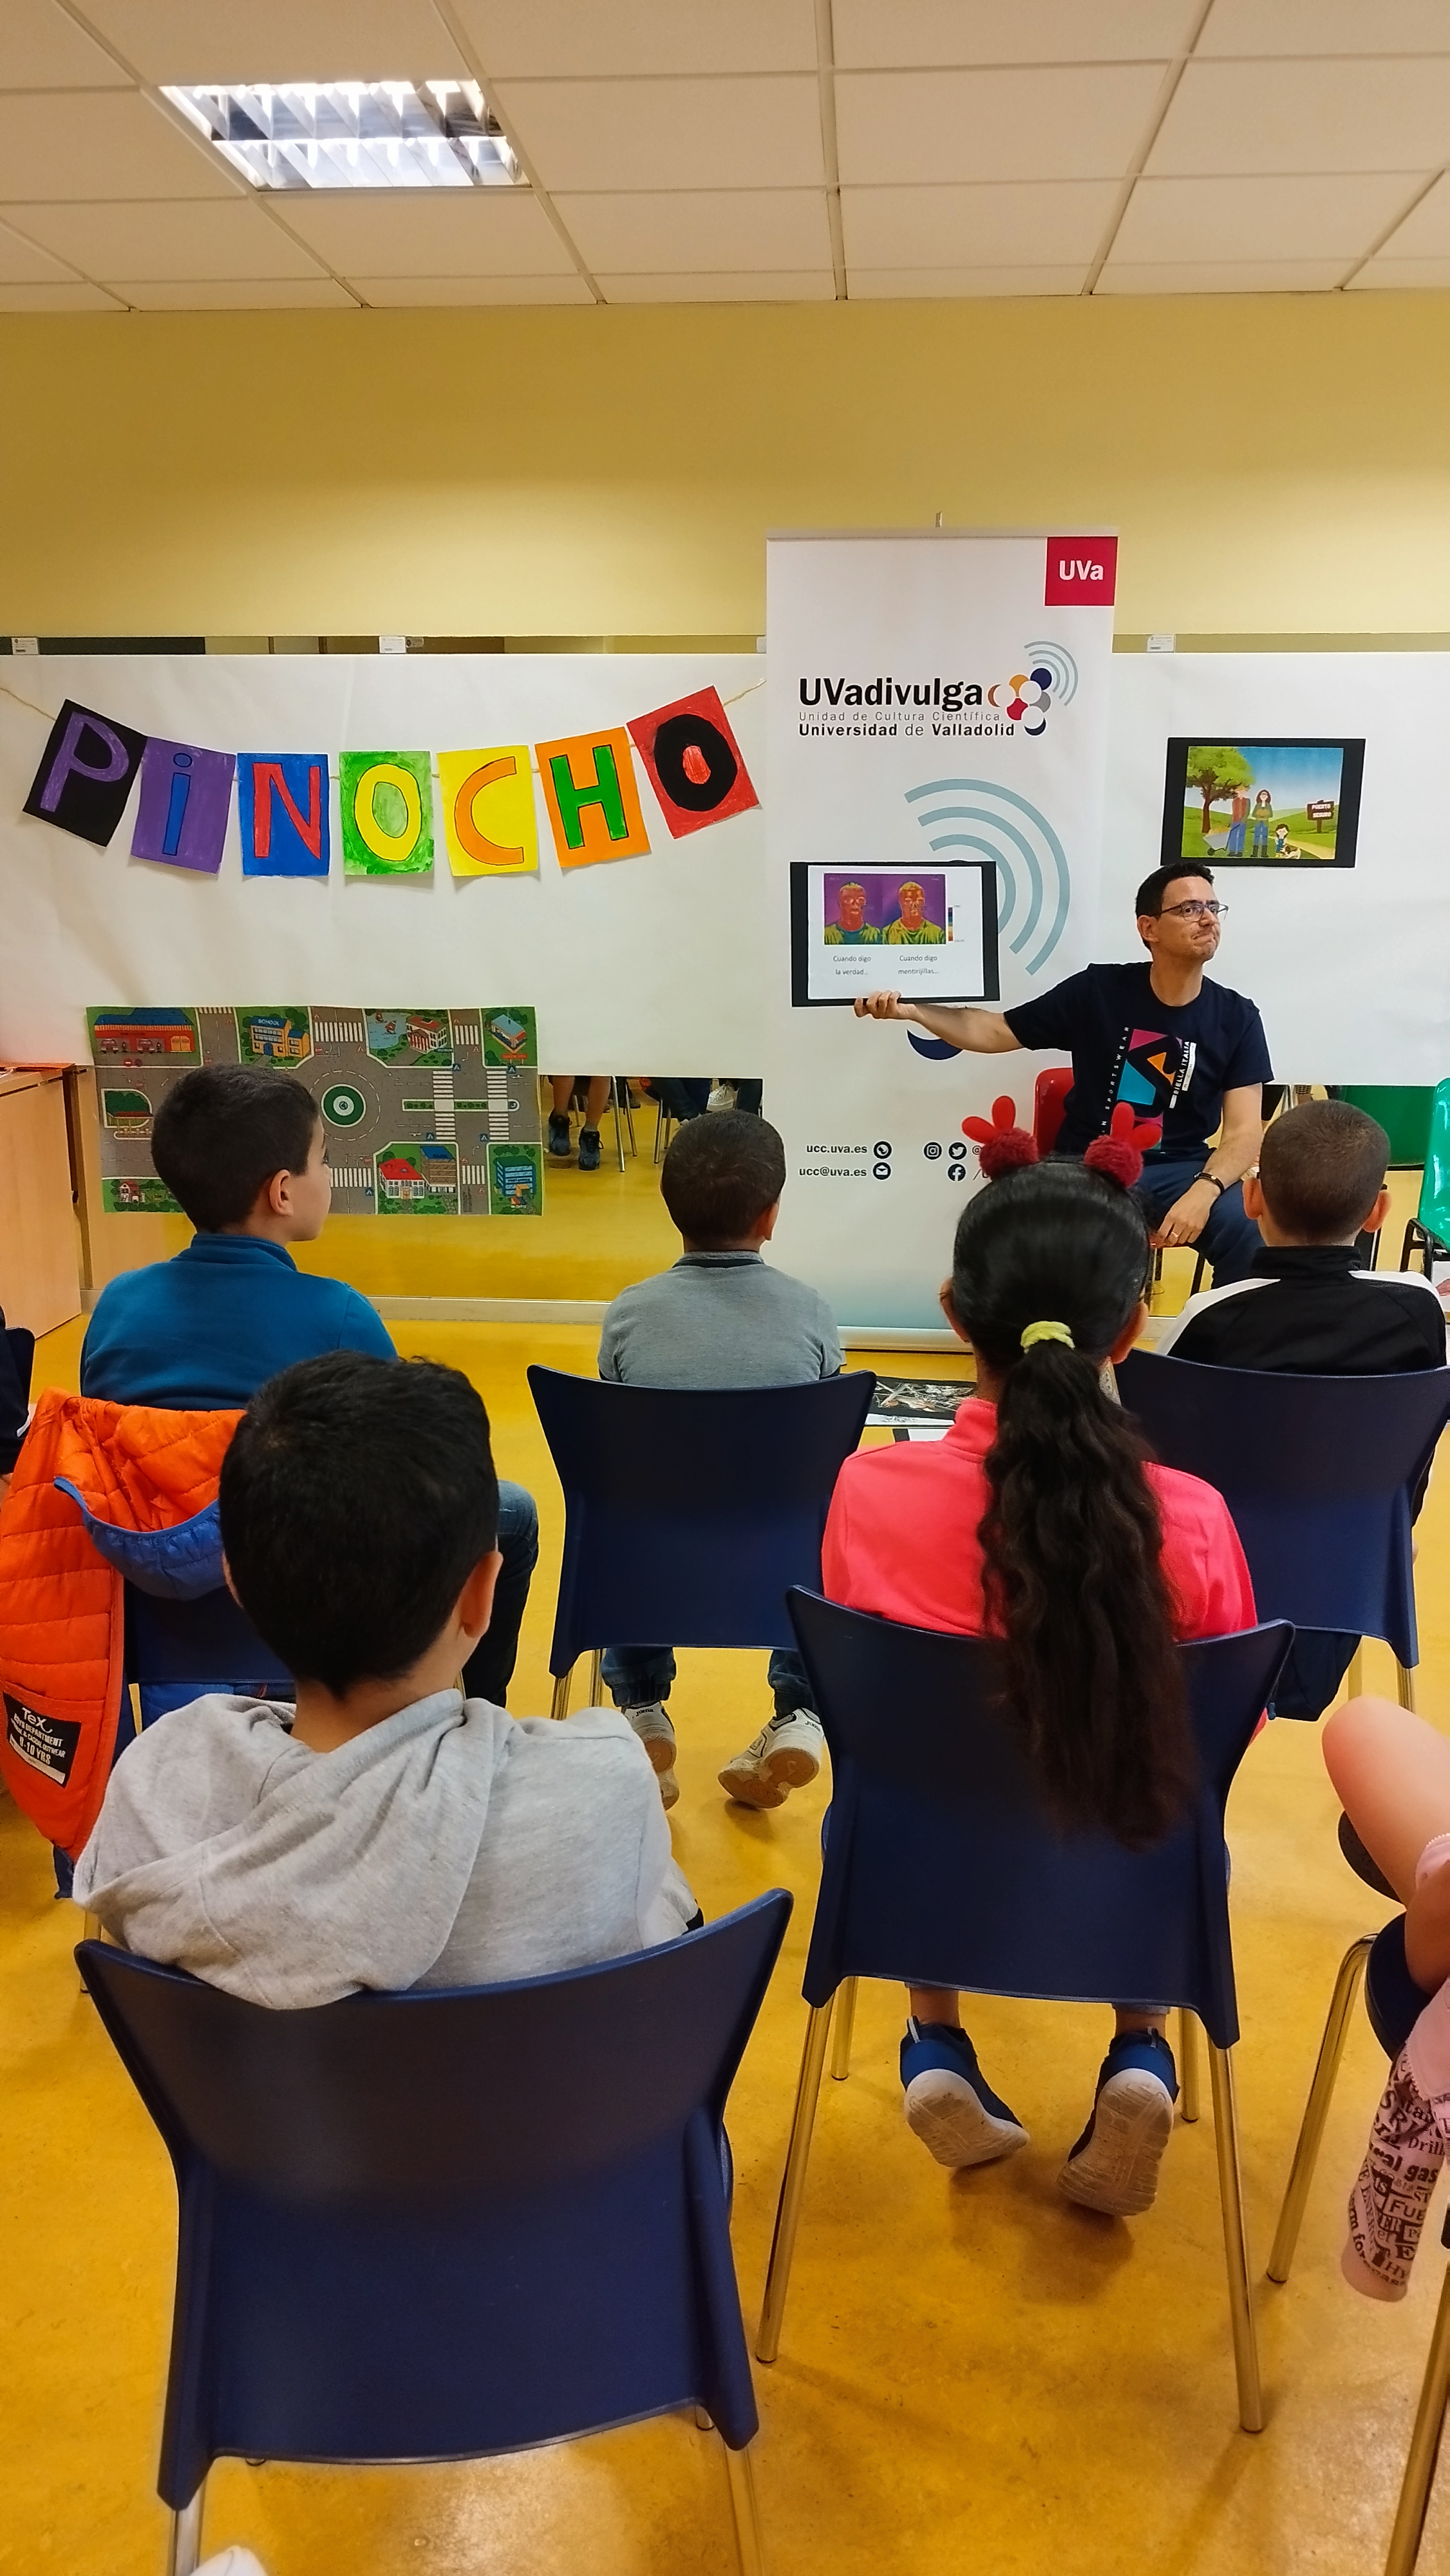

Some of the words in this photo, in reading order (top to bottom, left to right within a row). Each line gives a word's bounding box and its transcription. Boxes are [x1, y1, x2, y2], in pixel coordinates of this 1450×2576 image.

[1059, 560, 1104, 580] UVa
[799, 677, 983, 712] UVadivulga
[799, 712, 845, 721] Unidad
[853, 712, 867, 721] de
[875, 712, 925, 721] Cultura
[932, 711, 1000, 721] Científica
[799, 723, 898, 736] Universidad
[905, 723, 924, 736] de
[932, 723, 1015, 736] Valladolid
[1181, 1041, 1190, 1066] ITALIA
[1105, 1027, 1130, 1110] SPORTSWEAR
[806, 1144, 867, 1153] ucc.uva.es
[799, 1166, 867, 1177] ucc@uva.es
[26, 1723, 64, 1747] DEPARTMENT
[37, 1747, 52, 1765] YRS
[1404, 2164, 1438, 2183] gas
